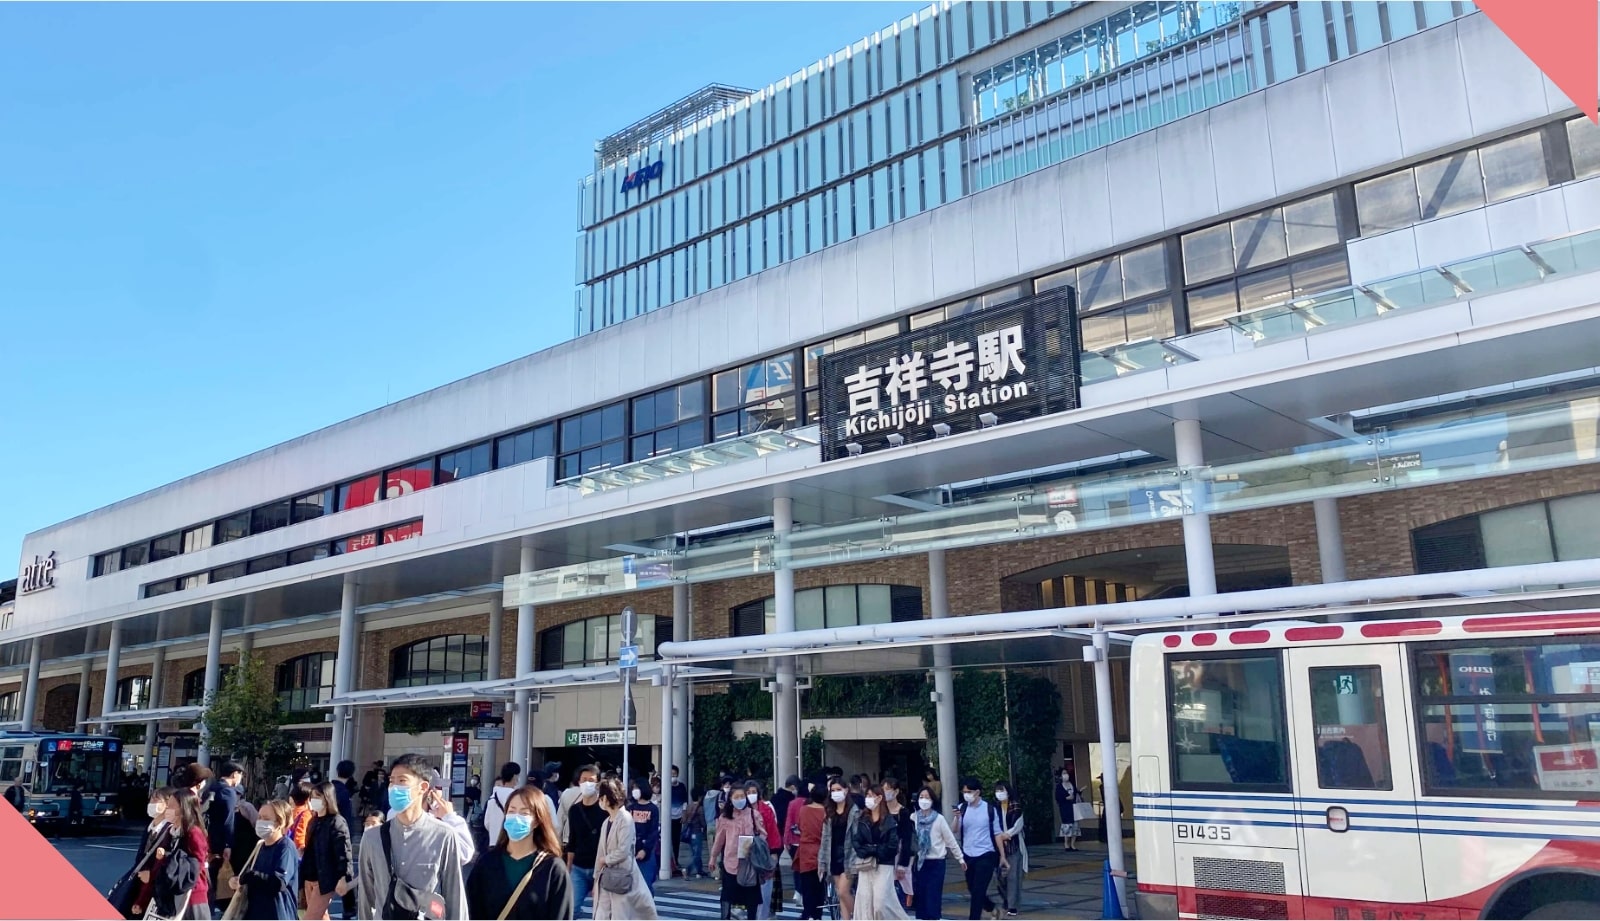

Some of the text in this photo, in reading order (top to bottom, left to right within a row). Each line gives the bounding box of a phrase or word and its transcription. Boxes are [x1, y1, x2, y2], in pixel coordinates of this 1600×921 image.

[844, 325, 1026, 416] 吉祥寺駅
[845, 380, 1028, 437] Kichijōji Station
[22, 550, 56, 593] atré
[472, 704, 479, 713] 3
[568, 733, 578, 742] JR
[580, 733, 606, 744] 吉祥寺駅
[456, 742, 464, 753] 3
[1177, 824, 1231, 840] B1435
